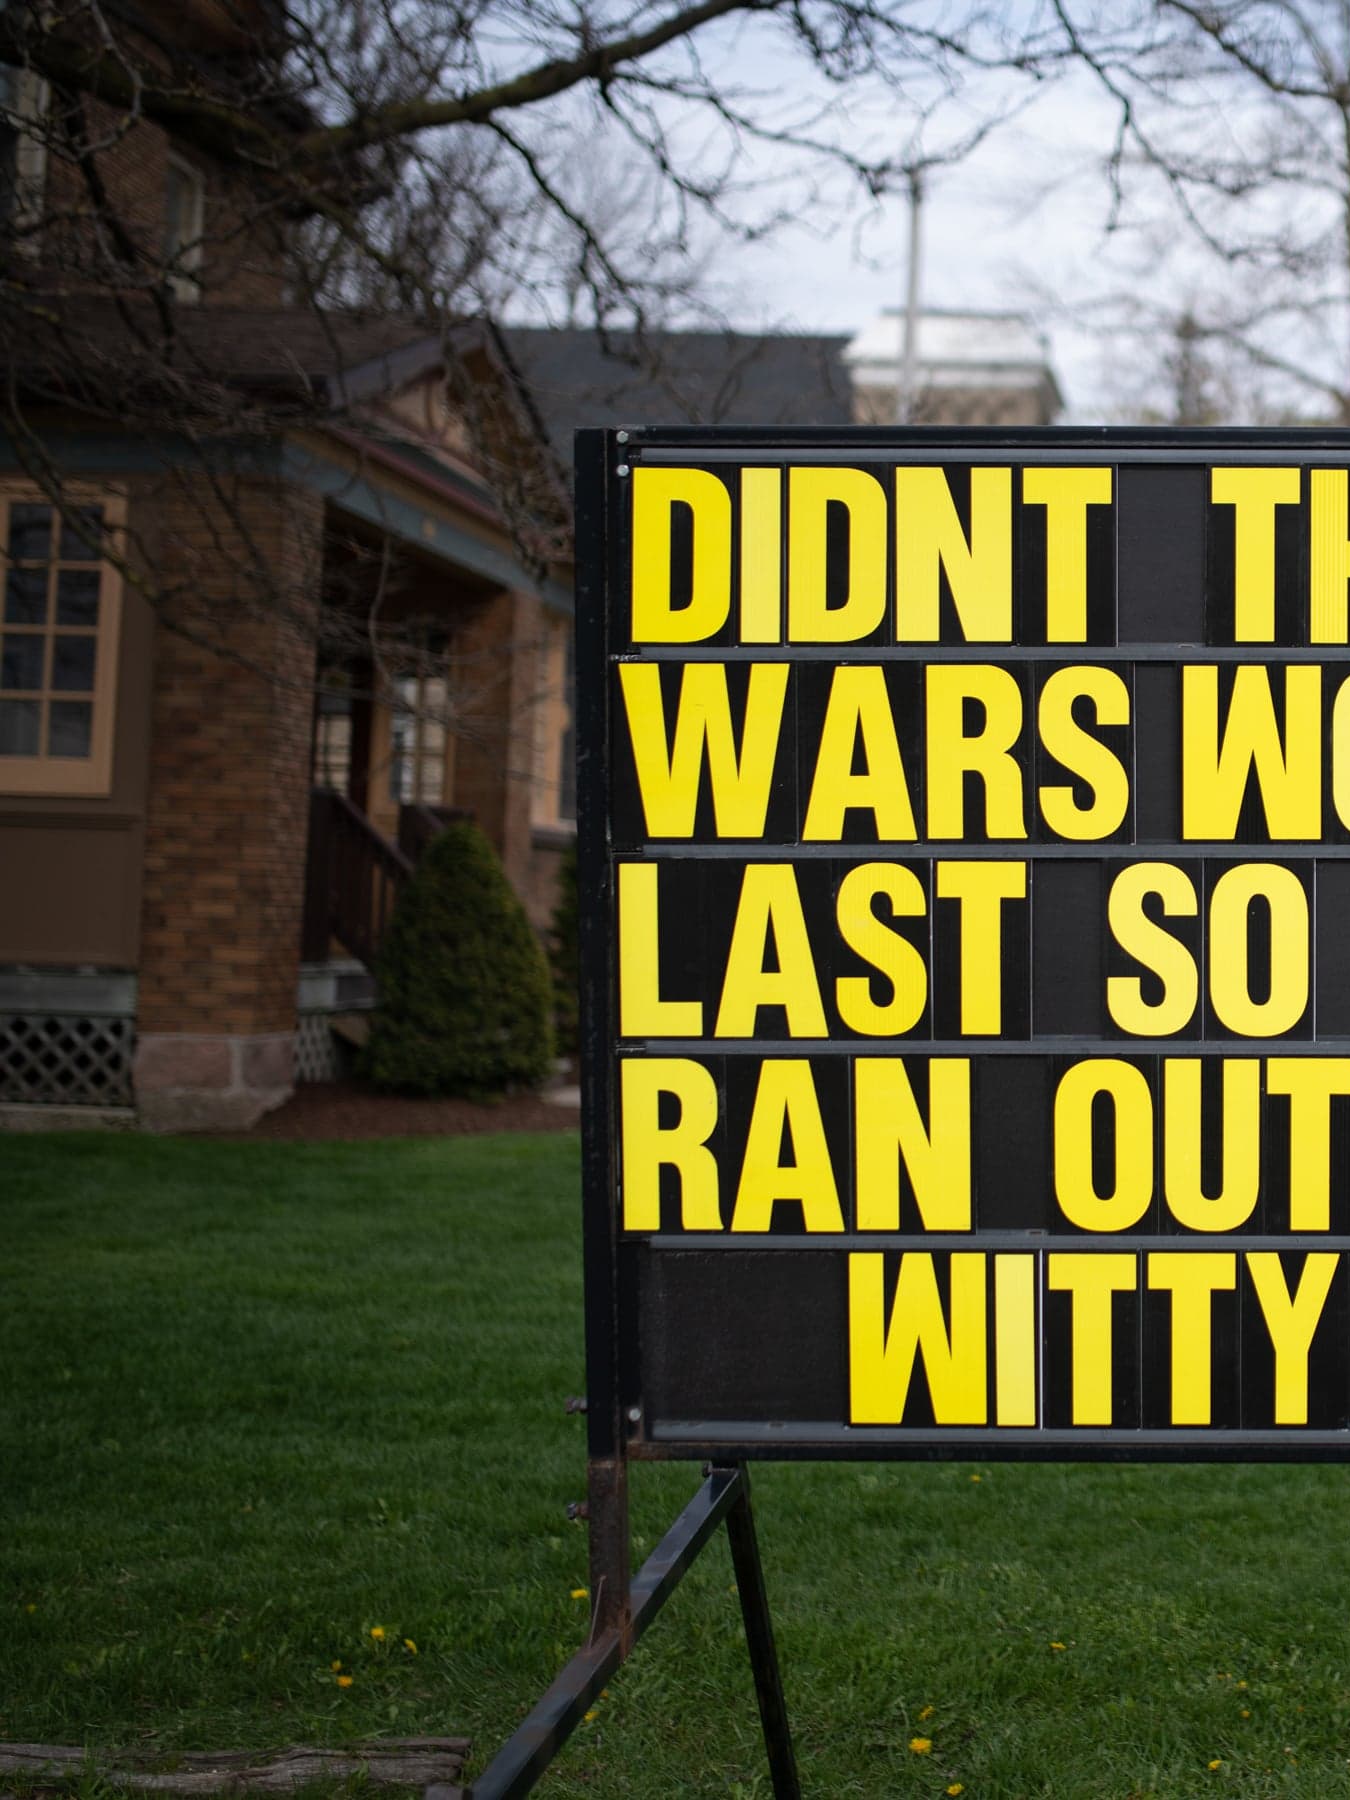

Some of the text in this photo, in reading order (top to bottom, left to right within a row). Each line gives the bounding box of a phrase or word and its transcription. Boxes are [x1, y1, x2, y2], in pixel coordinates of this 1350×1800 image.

[632, 467, 1112, 643] DIDNT
[619, 663, 1129, 840] WARS
[619, 861, 1026, 1037] LAST
[1107, 863, 1308, 1037] SO
[621, 1058, 971, 1232] RAN
[849, 1253, 1340, 1426] WITTY
